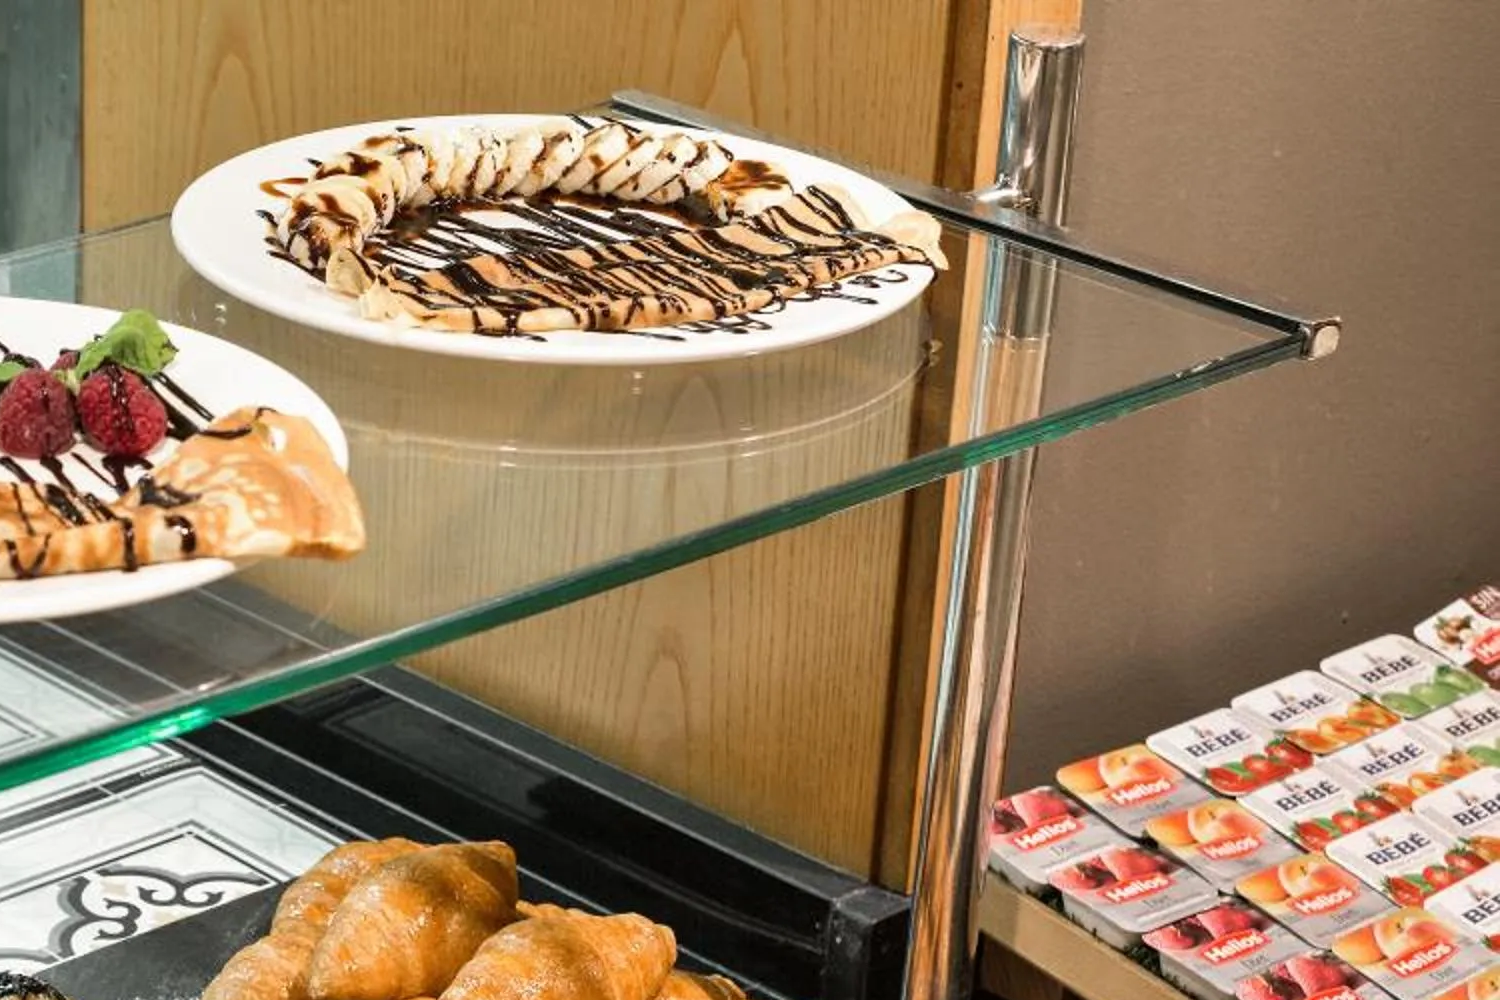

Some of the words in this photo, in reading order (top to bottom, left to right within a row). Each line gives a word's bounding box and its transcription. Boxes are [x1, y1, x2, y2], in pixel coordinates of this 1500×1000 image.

[1452, 792, 1500, 827] BEB
[1012, 820, 1076, 849] Helios
[1106, 877, 1168, 903] Helios
[1294, 888, 1352, 915] Helios
[1204, 932, 1265, 964] Helios
[1392, 943, 1451, 976] Helios
